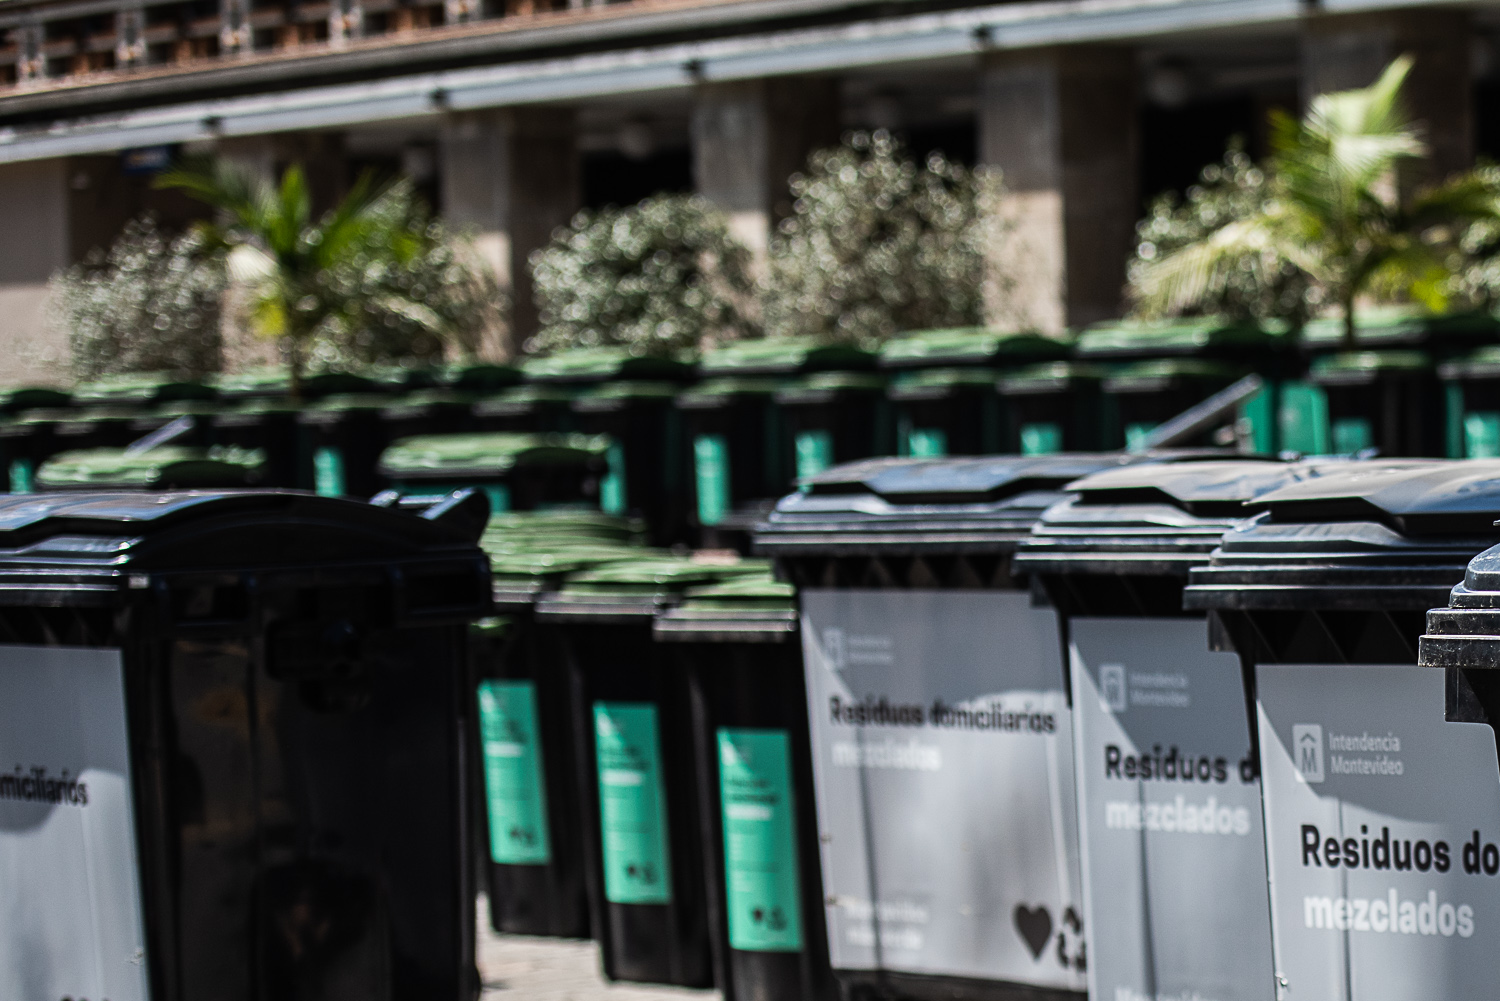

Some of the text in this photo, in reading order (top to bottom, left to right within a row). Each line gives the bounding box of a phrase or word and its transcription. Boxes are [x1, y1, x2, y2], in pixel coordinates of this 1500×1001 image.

[1329, 732, 1400, 752] Intendencia
[1106, 744, 1229, 783] Residuos
[1331, 755, 1404, 776] Montevideo
[1106, 796, 1250, 835] mezclados
[1301, 824, 1452, 874] Residuos
[1304, 887, 1475, 938] mezclados
